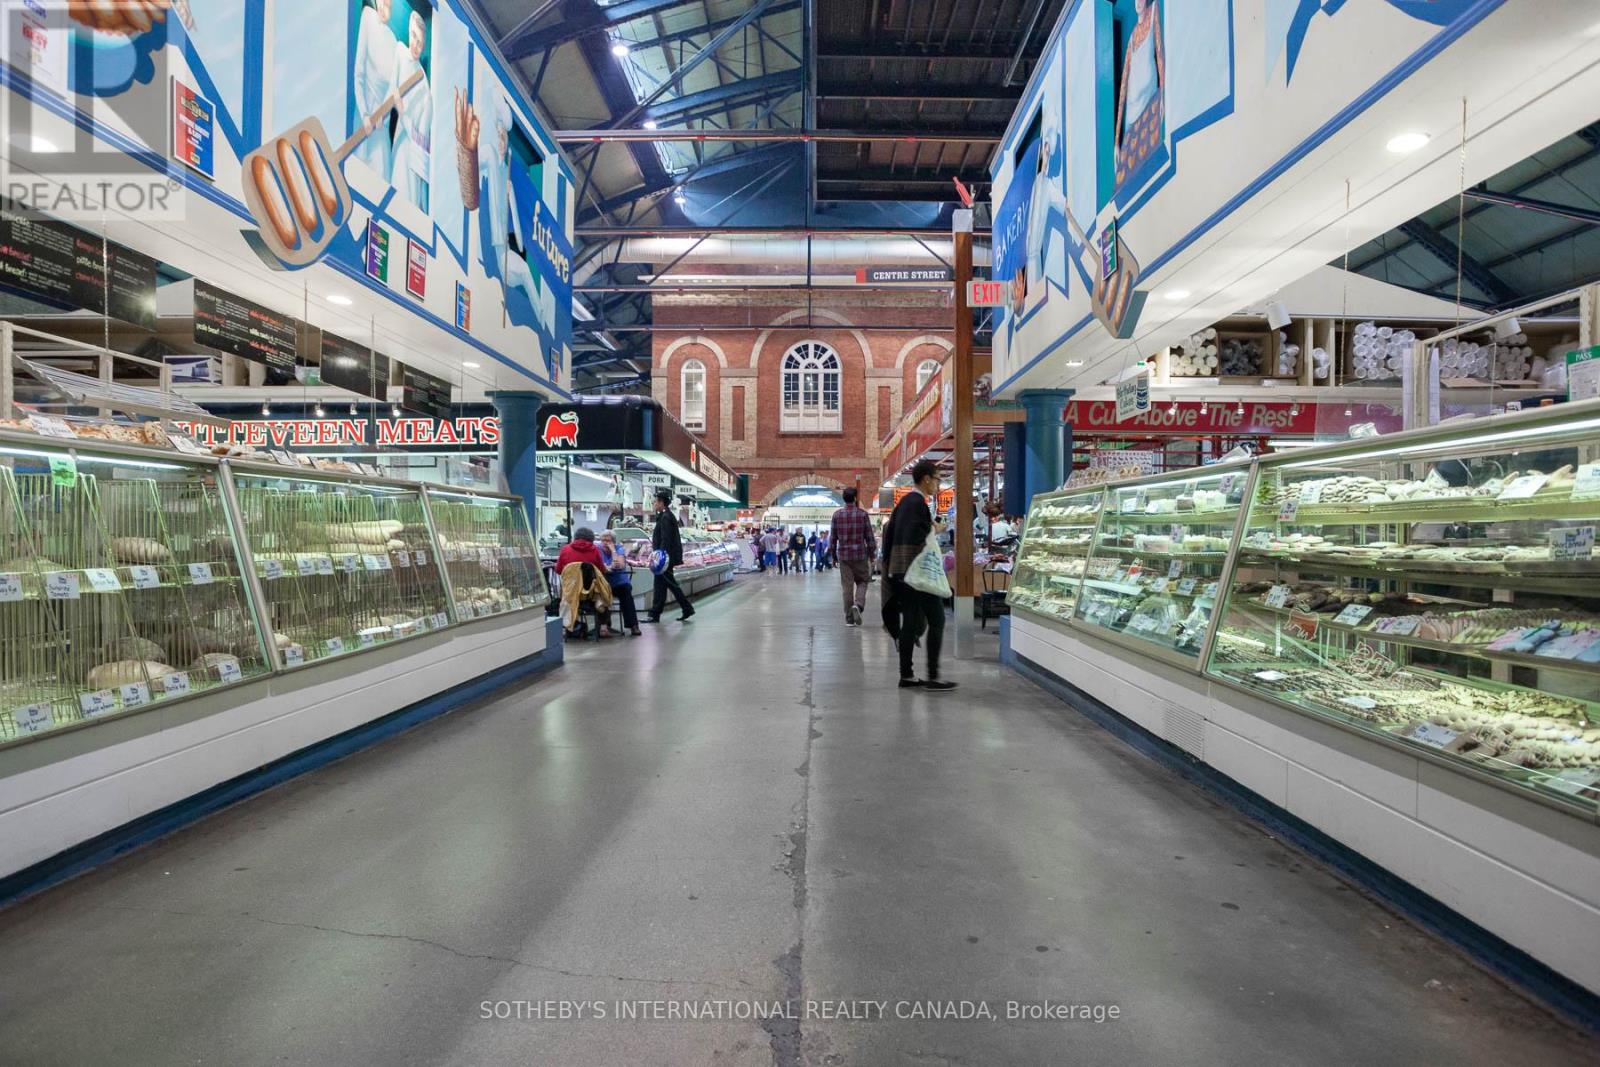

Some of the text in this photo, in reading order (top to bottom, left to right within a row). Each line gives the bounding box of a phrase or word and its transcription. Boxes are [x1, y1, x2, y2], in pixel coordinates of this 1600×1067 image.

[532, 200, 569, 284] future
[996, 203, 1028, 272] BAKERY
[873, 271, 946, 280] CENTRE STREET
[973, 283, 1001, 304] EXIT
[1575, 351, 1592, 362] PASS
[1064, 402, 1080, 425] A
[1089, 401, 1121, 425] Cu
[1208, 404, 1242, 427] The
[376, 417, 500, 445] MEATS
[648, 476, 665, 484] PORK
